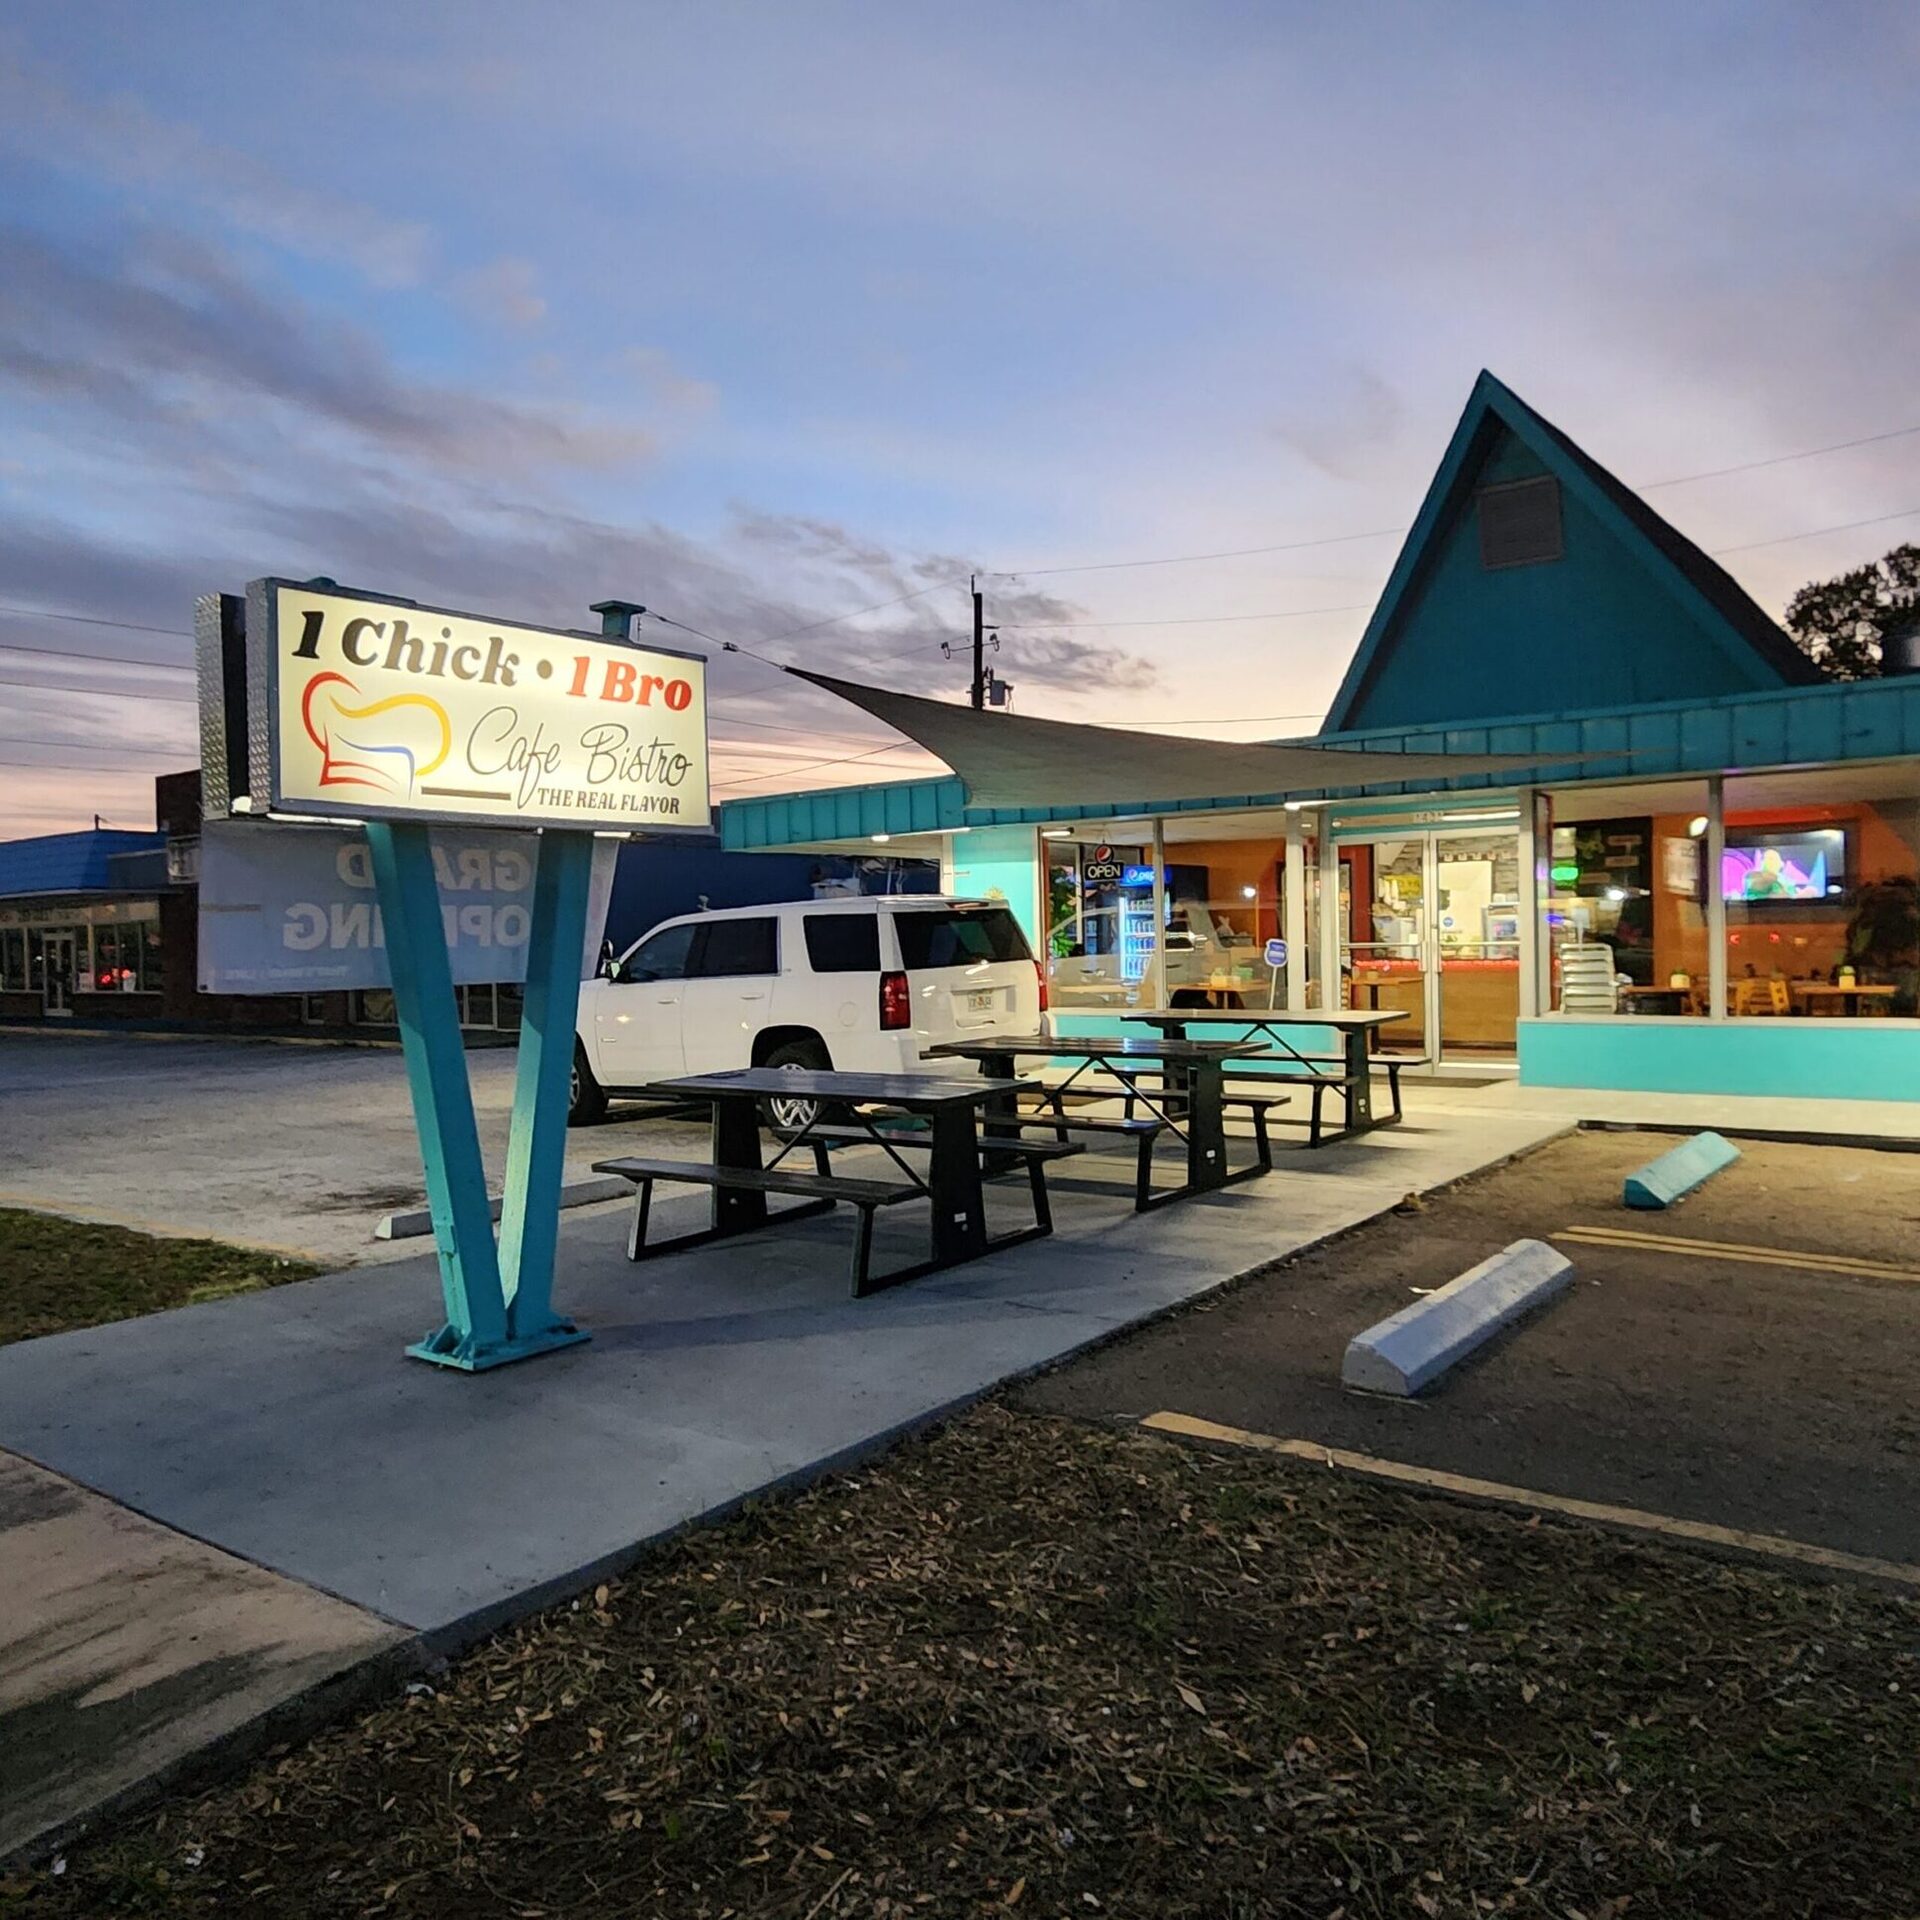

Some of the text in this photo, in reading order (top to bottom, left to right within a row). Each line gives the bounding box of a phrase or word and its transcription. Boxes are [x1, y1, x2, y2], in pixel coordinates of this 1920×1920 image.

[292, 611, 692, 711] 1 Chick 1 Bro
[467, 706, 693, 809] Cafe Bistro
[537, 788, 680, 814] THE REAL FLAVOR
[1088, 865, 1121, 878] OPEN
